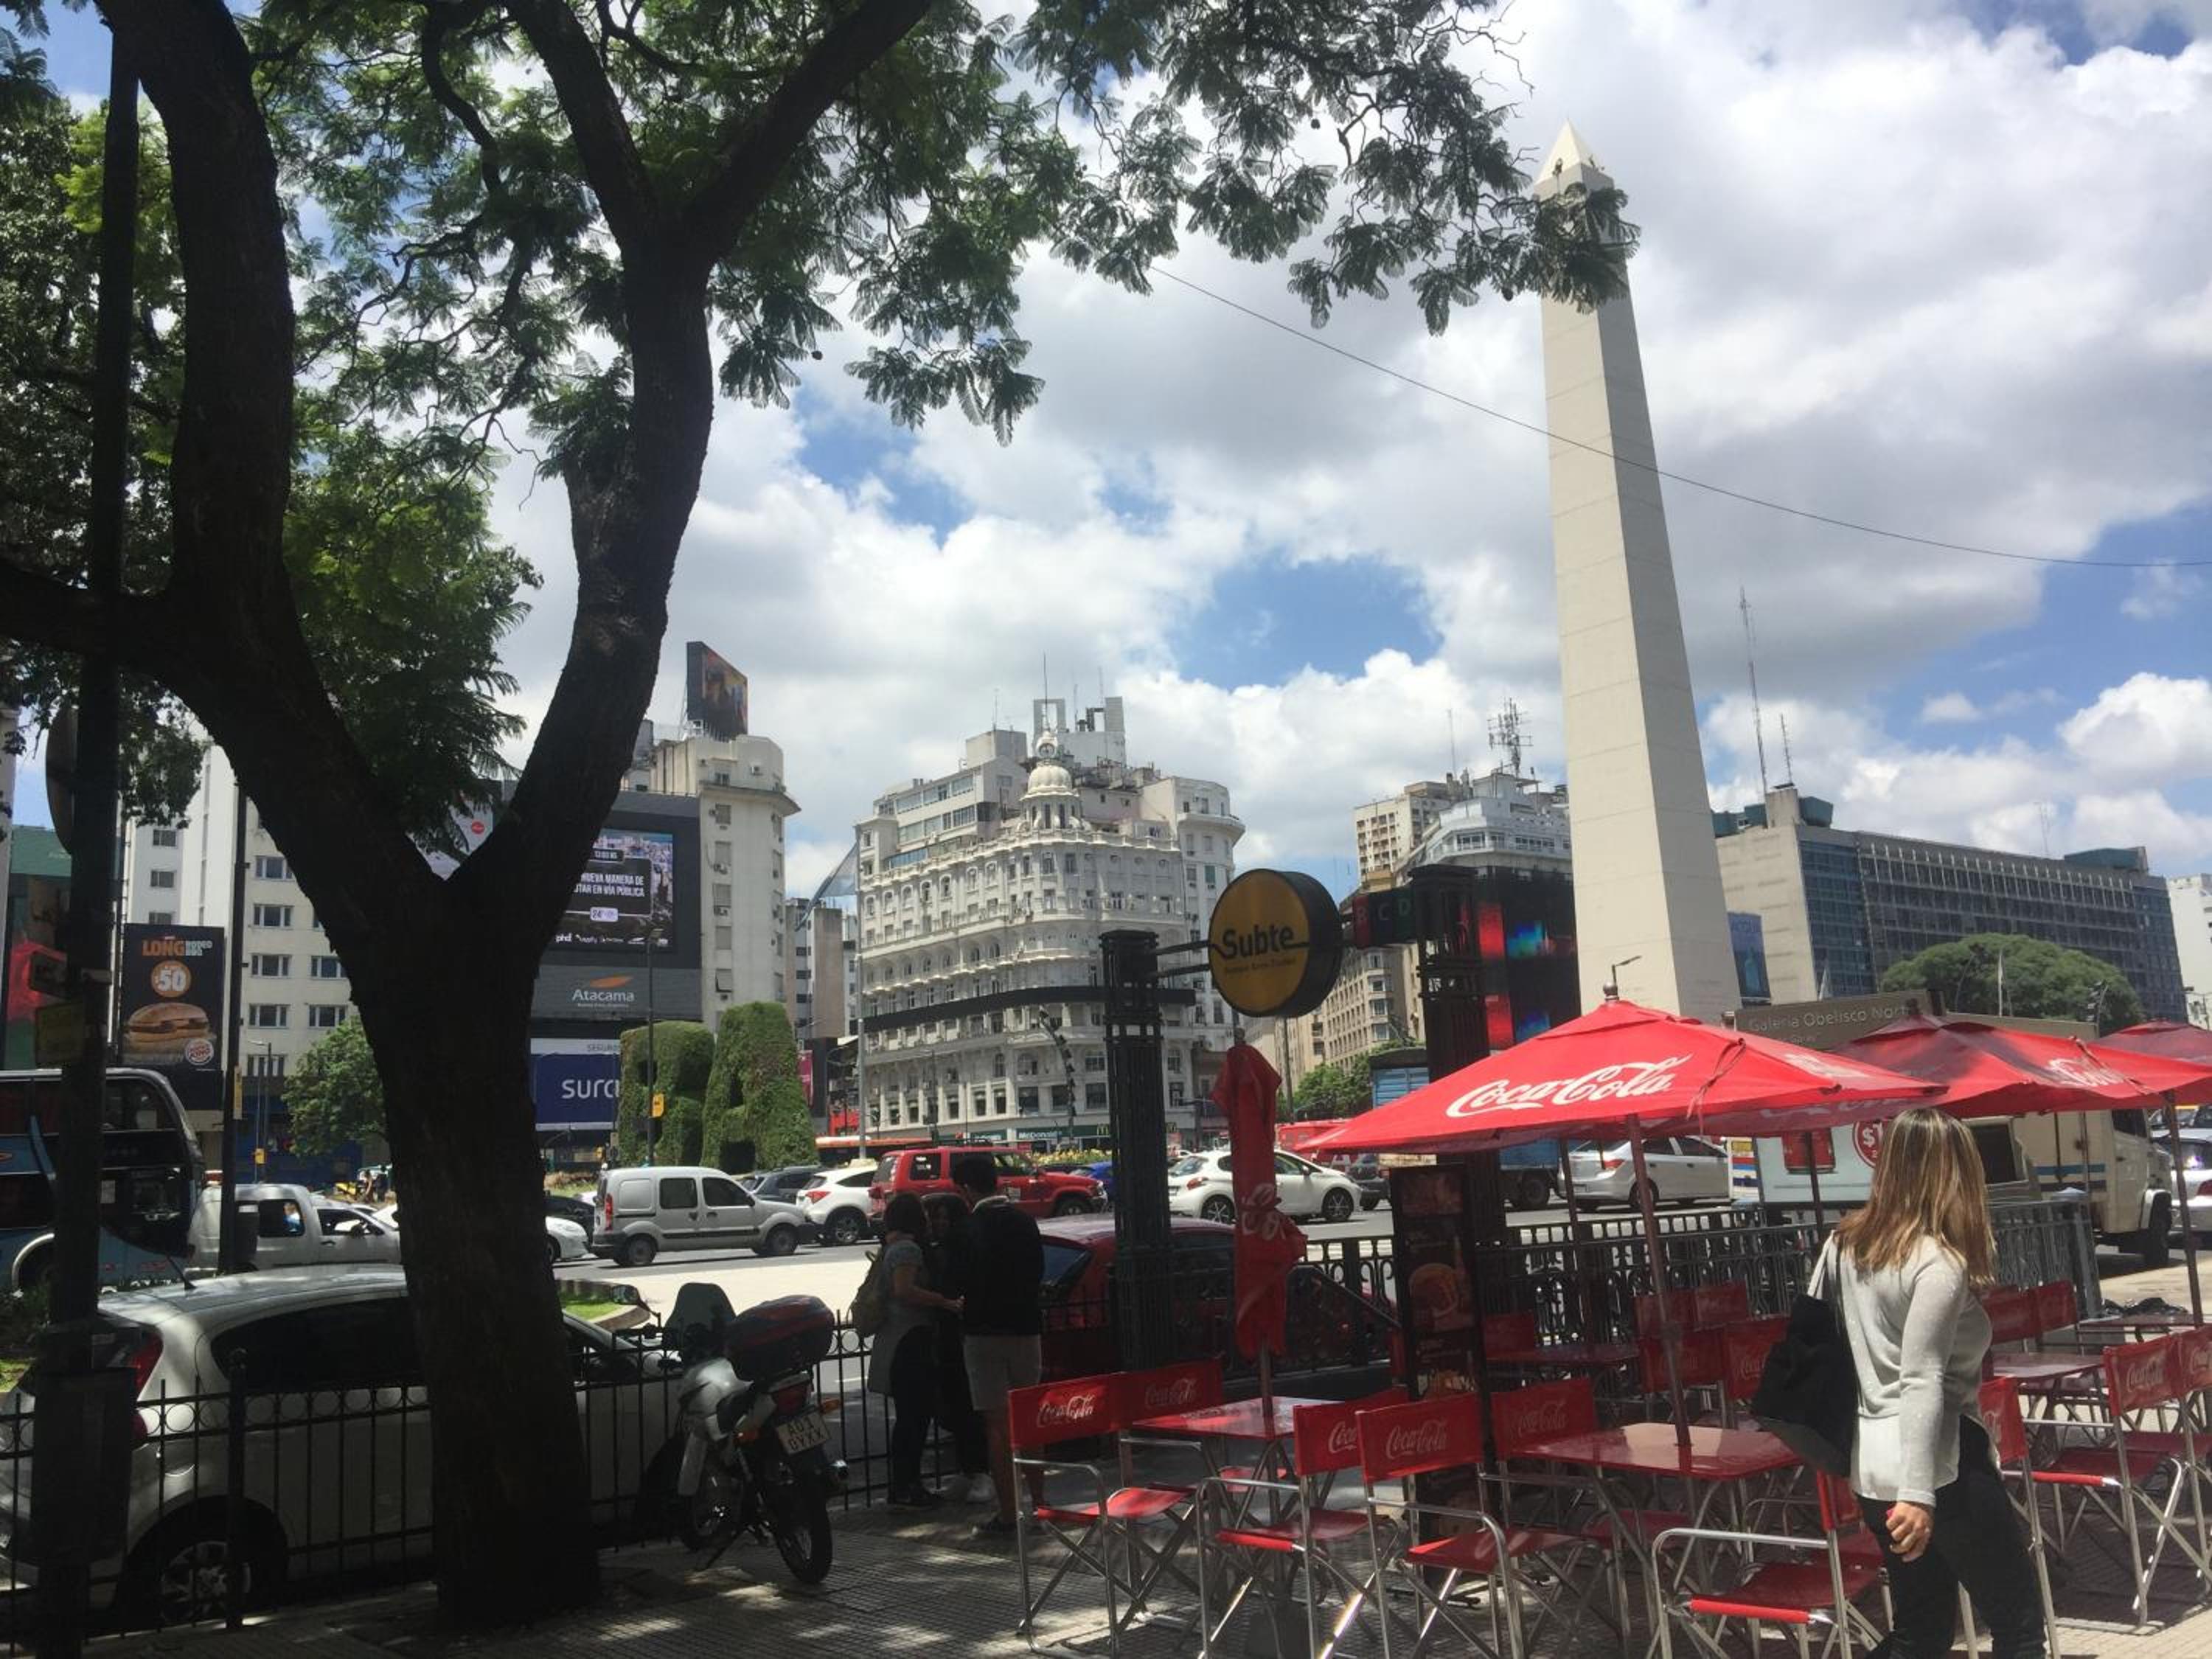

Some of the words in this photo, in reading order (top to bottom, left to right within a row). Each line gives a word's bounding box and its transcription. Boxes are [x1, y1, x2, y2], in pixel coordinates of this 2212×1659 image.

[593, 885, 602, 894] EN
[605, 874, 633, 885] MANERA
[635, 875, 644, 886] DE
[1378, 901, 1389, 921] C
[1397, 897, 1411, 916] D
[142, 940, 185, 956] LONG
[1222, 924, 1294, 959] Subte
[572, 990, 635, 1002] Atacama
[1446, 1054, 1692, 1117] Coca-Cola
[1386, 1418, 1452, 1460] Coca-Cola
